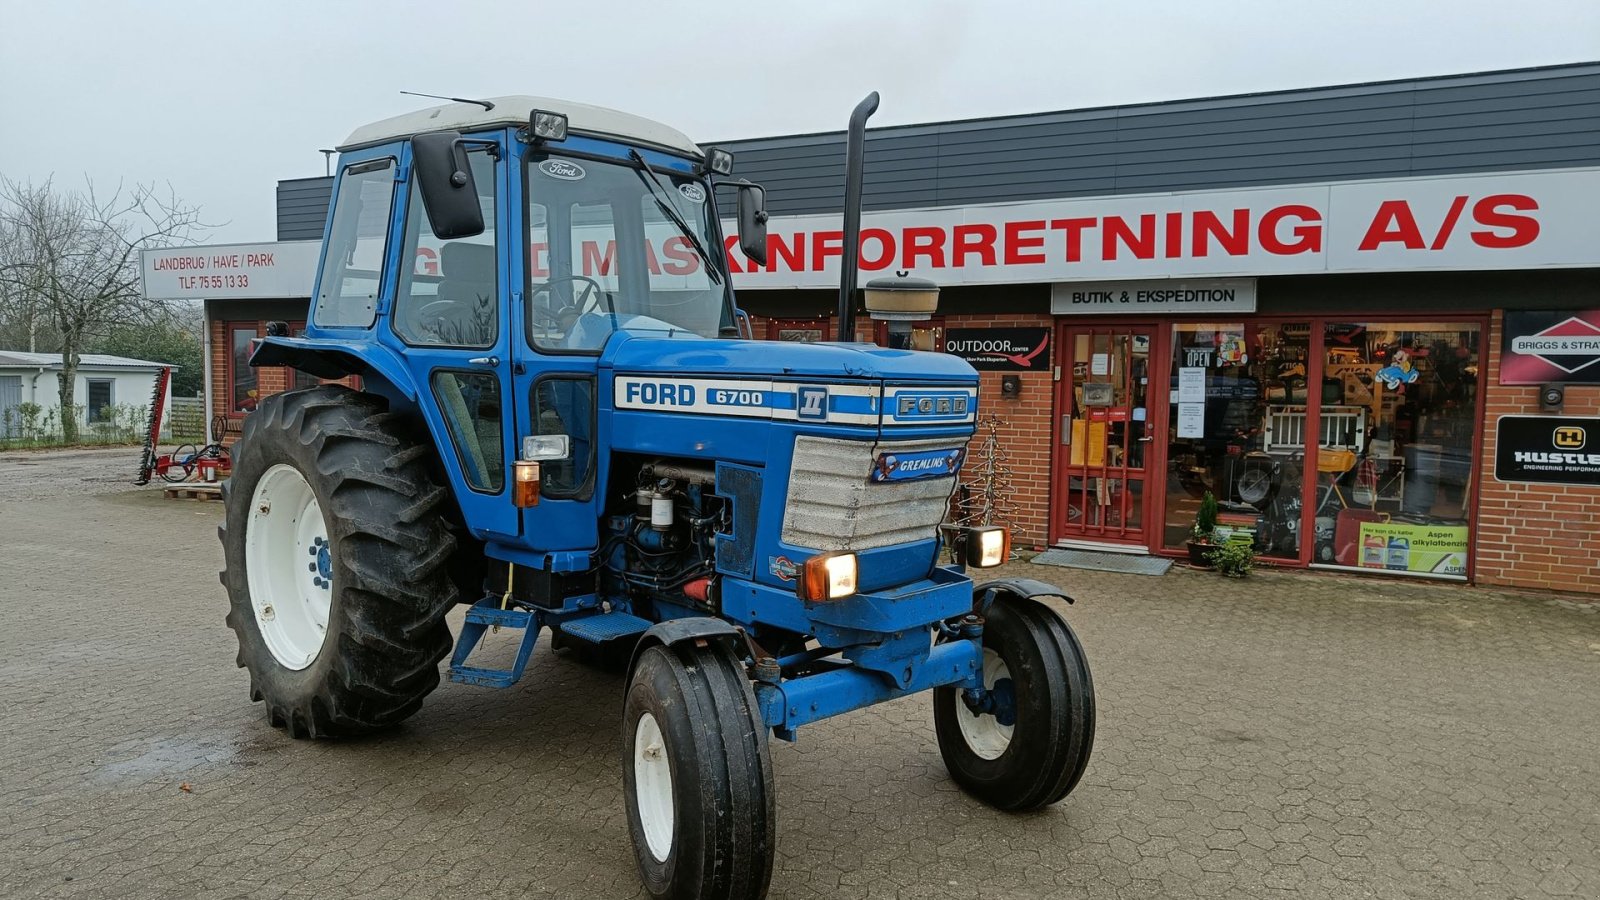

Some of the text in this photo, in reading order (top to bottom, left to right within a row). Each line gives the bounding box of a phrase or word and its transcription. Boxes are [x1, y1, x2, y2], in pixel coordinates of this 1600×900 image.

[549, 161, 577, 178] Ford
[683, 186, 702, 200] Ford
[1358, 194, 1540, 251] A/S
[153, 257, 205, 271] LANDBRUG
[213, 255, 238, 269] HAVE
[247, 253, 275, 267] PARK
[178, 274, 249, 289] TLF. 75 55 13 33
[1072, 289, 1235, 304] BUTIK & EKSPEDITION
[946, 340, 1011, 352] OUTDOOR
[1518, 341, 1600, 350] BRIGGS & STRA
[1187, 352, 1210, 367] OPEN
[626, 382, 695, 406] FORD
[715, 390, 763, 405] 6700
[900, 397, 967, 413] FORD
[900, 457, 944, 471] GREMLINS
